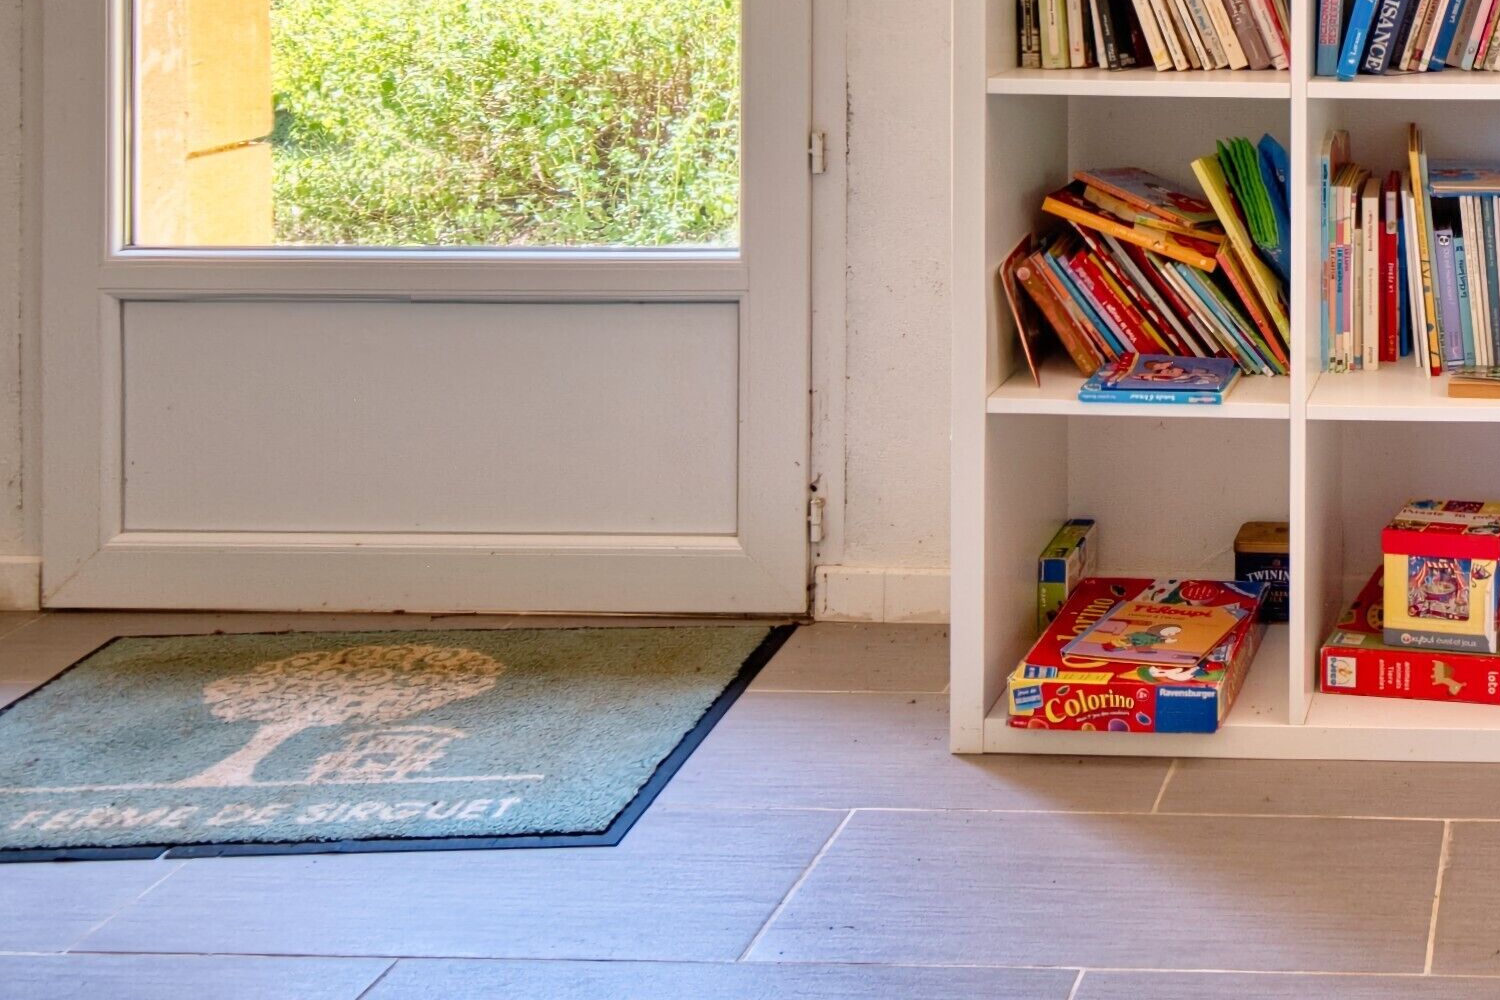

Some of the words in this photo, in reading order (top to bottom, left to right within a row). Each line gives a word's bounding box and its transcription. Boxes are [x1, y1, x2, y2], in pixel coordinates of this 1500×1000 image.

[1448, 14, 1456, 24] LA
[1327, 25, 1338, 45] DES
[1387, 285, 1394, 293] LA
[1117, 321, 1127, 330] le
[1123, 327, 1138, 343] Vive
[1487, 671, 1497, 695] loto
[1159, 688, 1216, 698] Ravensburger
[1045, 689, 1135, 723] Colorino
[9, 806, 201, 833] FERME
[208, 804, 284, 825] DE
[294, 796, 524, 824] SIRGUET
